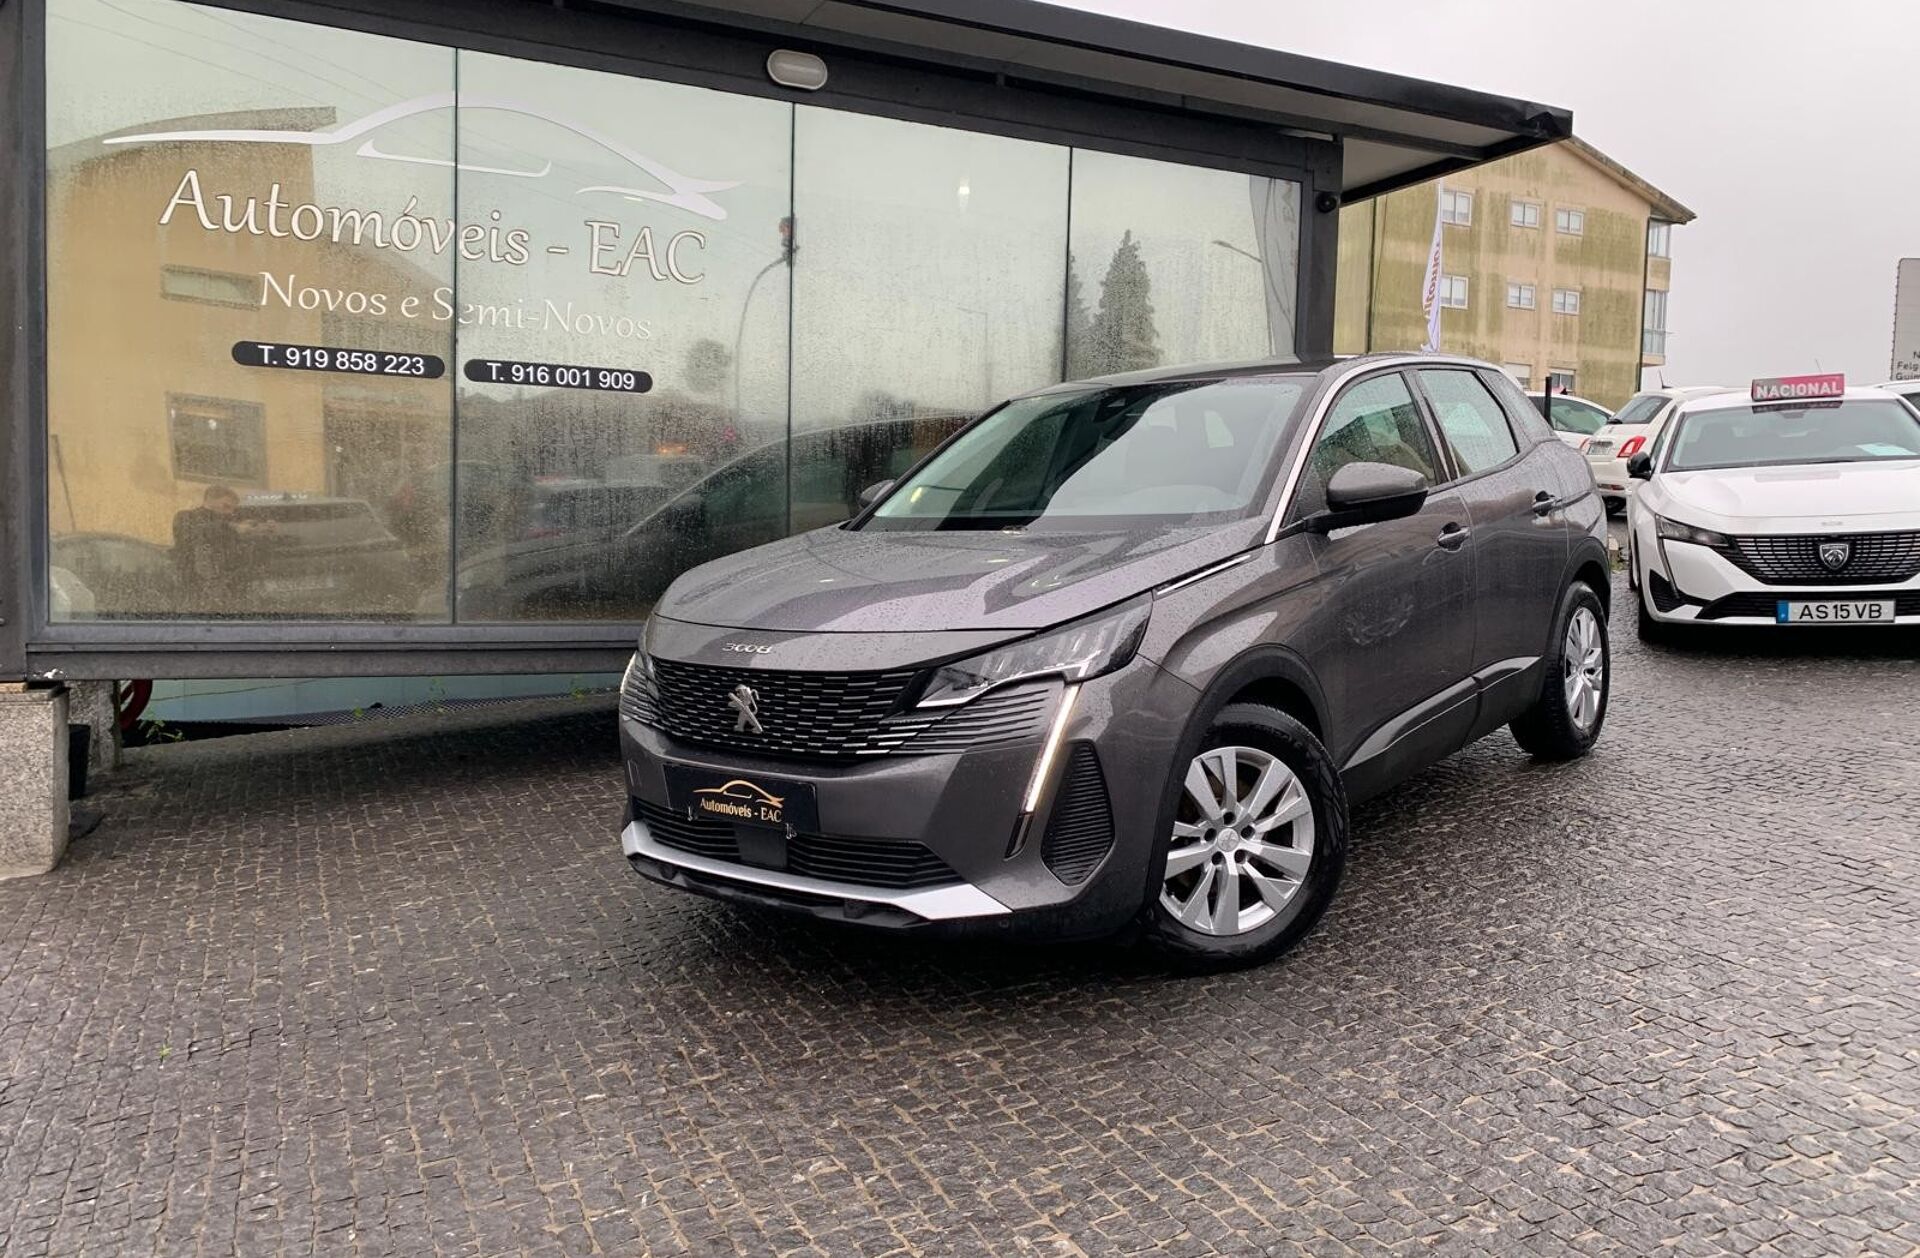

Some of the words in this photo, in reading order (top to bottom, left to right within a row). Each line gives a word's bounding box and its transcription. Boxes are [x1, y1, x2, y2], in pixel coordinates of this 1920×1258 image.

[159, 168, 530, 265] Automóveis
[584, 219, 706, 284] EAC
[259, 271, 387, 316] Novos
[400, 294, 420, 318] e
[432, 287, 651, 340] Semi-Novos
[257, 345, 278, 365] T.
[286, 347, 329, 369] 919
[335, 351, 377, 372] 858
[383, 354, 425, 376] 223
[486, 362, 504, 382] T.
[511, 364, 550, 385] 916
[555, 367, 592, 388] 001
[598, 370, 636, 390] 909
[1756, 381, 1843, 399] NACIONAL
[1799, 604, 1829, 620] AS
[1832, 603, 1851, 619] 15
[1854, 603, 1883, 619] VB
[700, 797, 752, 818] Automóveis
[760, 806, 782, 823] EAC
